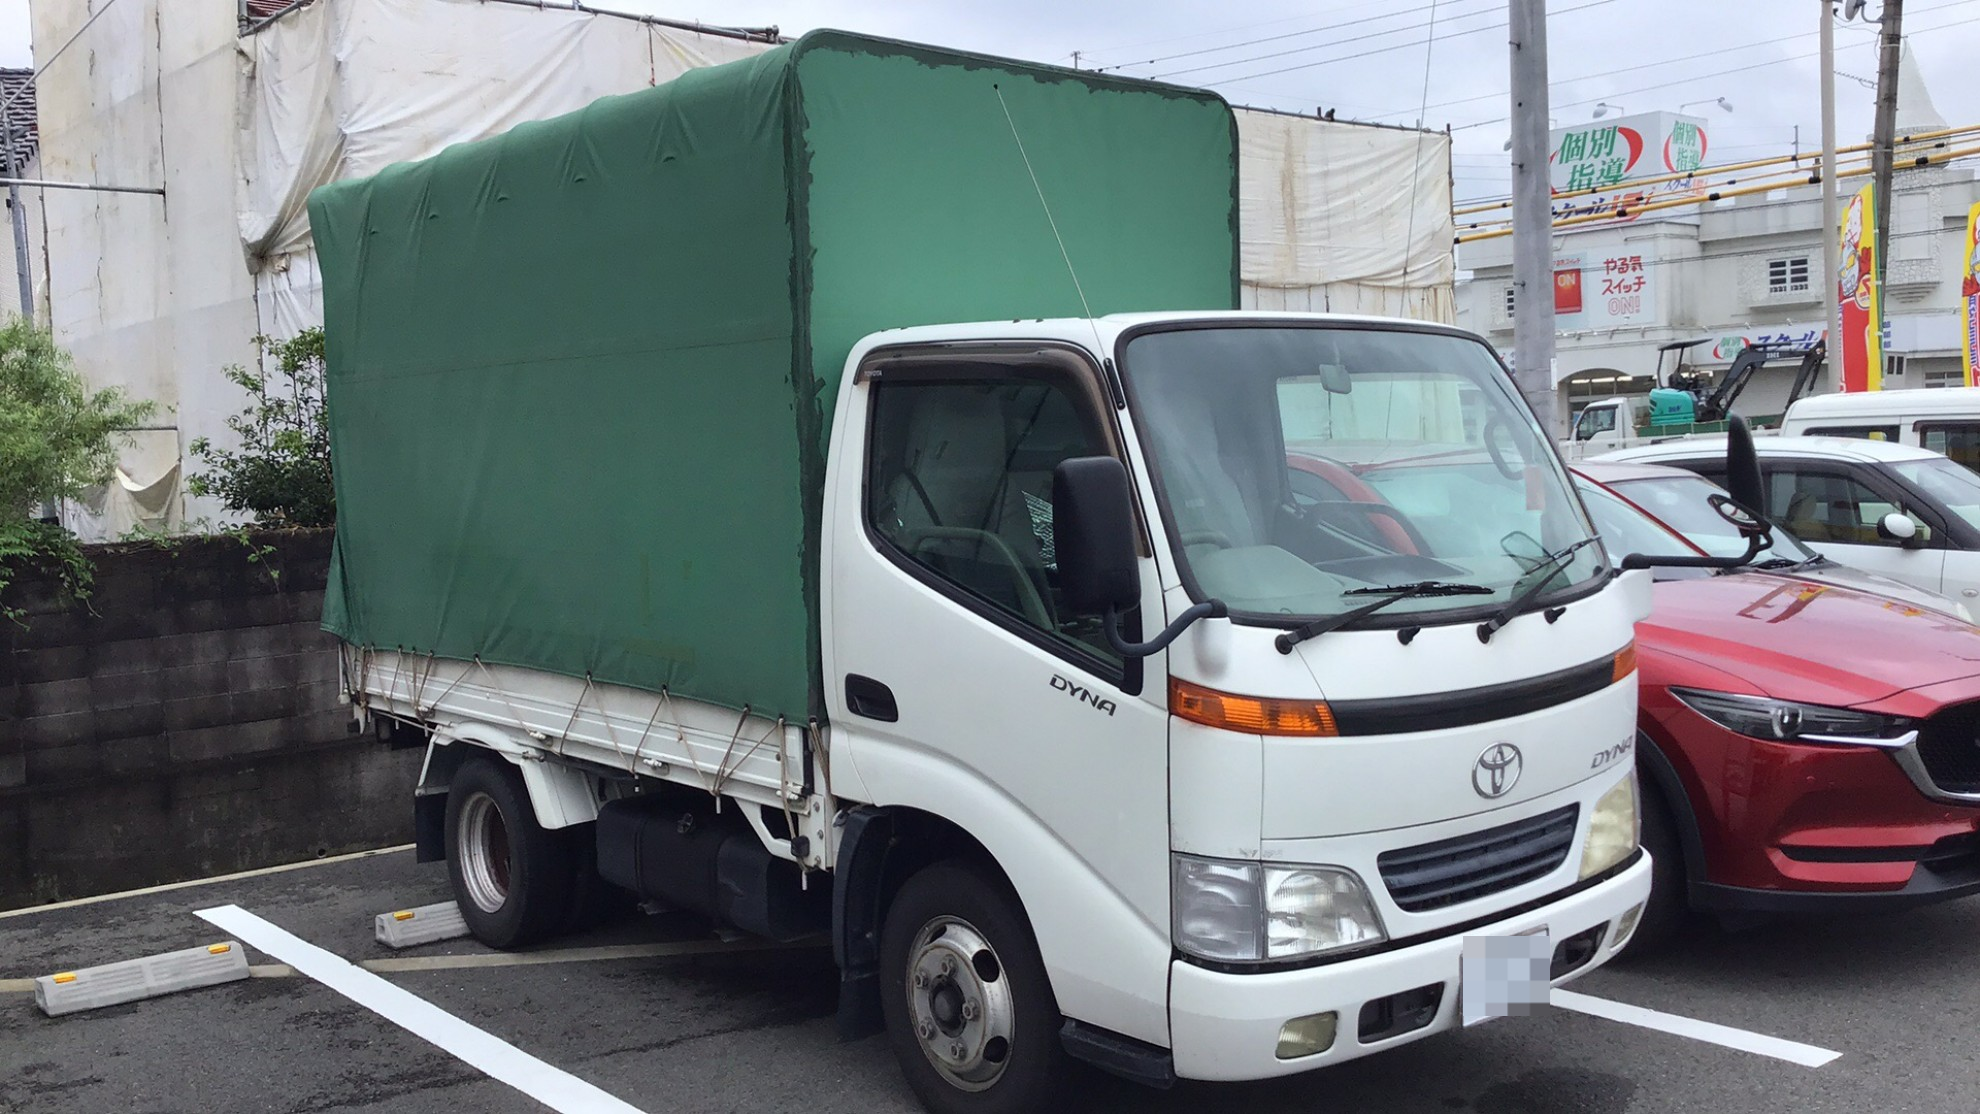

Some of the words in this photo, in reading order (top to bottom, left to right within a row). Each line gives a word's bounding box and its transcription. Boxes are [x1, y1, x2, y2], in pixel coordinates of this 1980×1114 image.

[1558, 126, 1618, 165] 個別
[1566, 157, 1628, 191] 指導
[1603, 255, 1644, 275] やる気
[1557, 273, 1576, 287] ON
[1601, 275, 1646, 295] スイッチ
[1608, 296, 1641, 316] ON!
[1049, 673, 1117, 717] DYNA
[1590, 735, 1633, 769] DYNA
